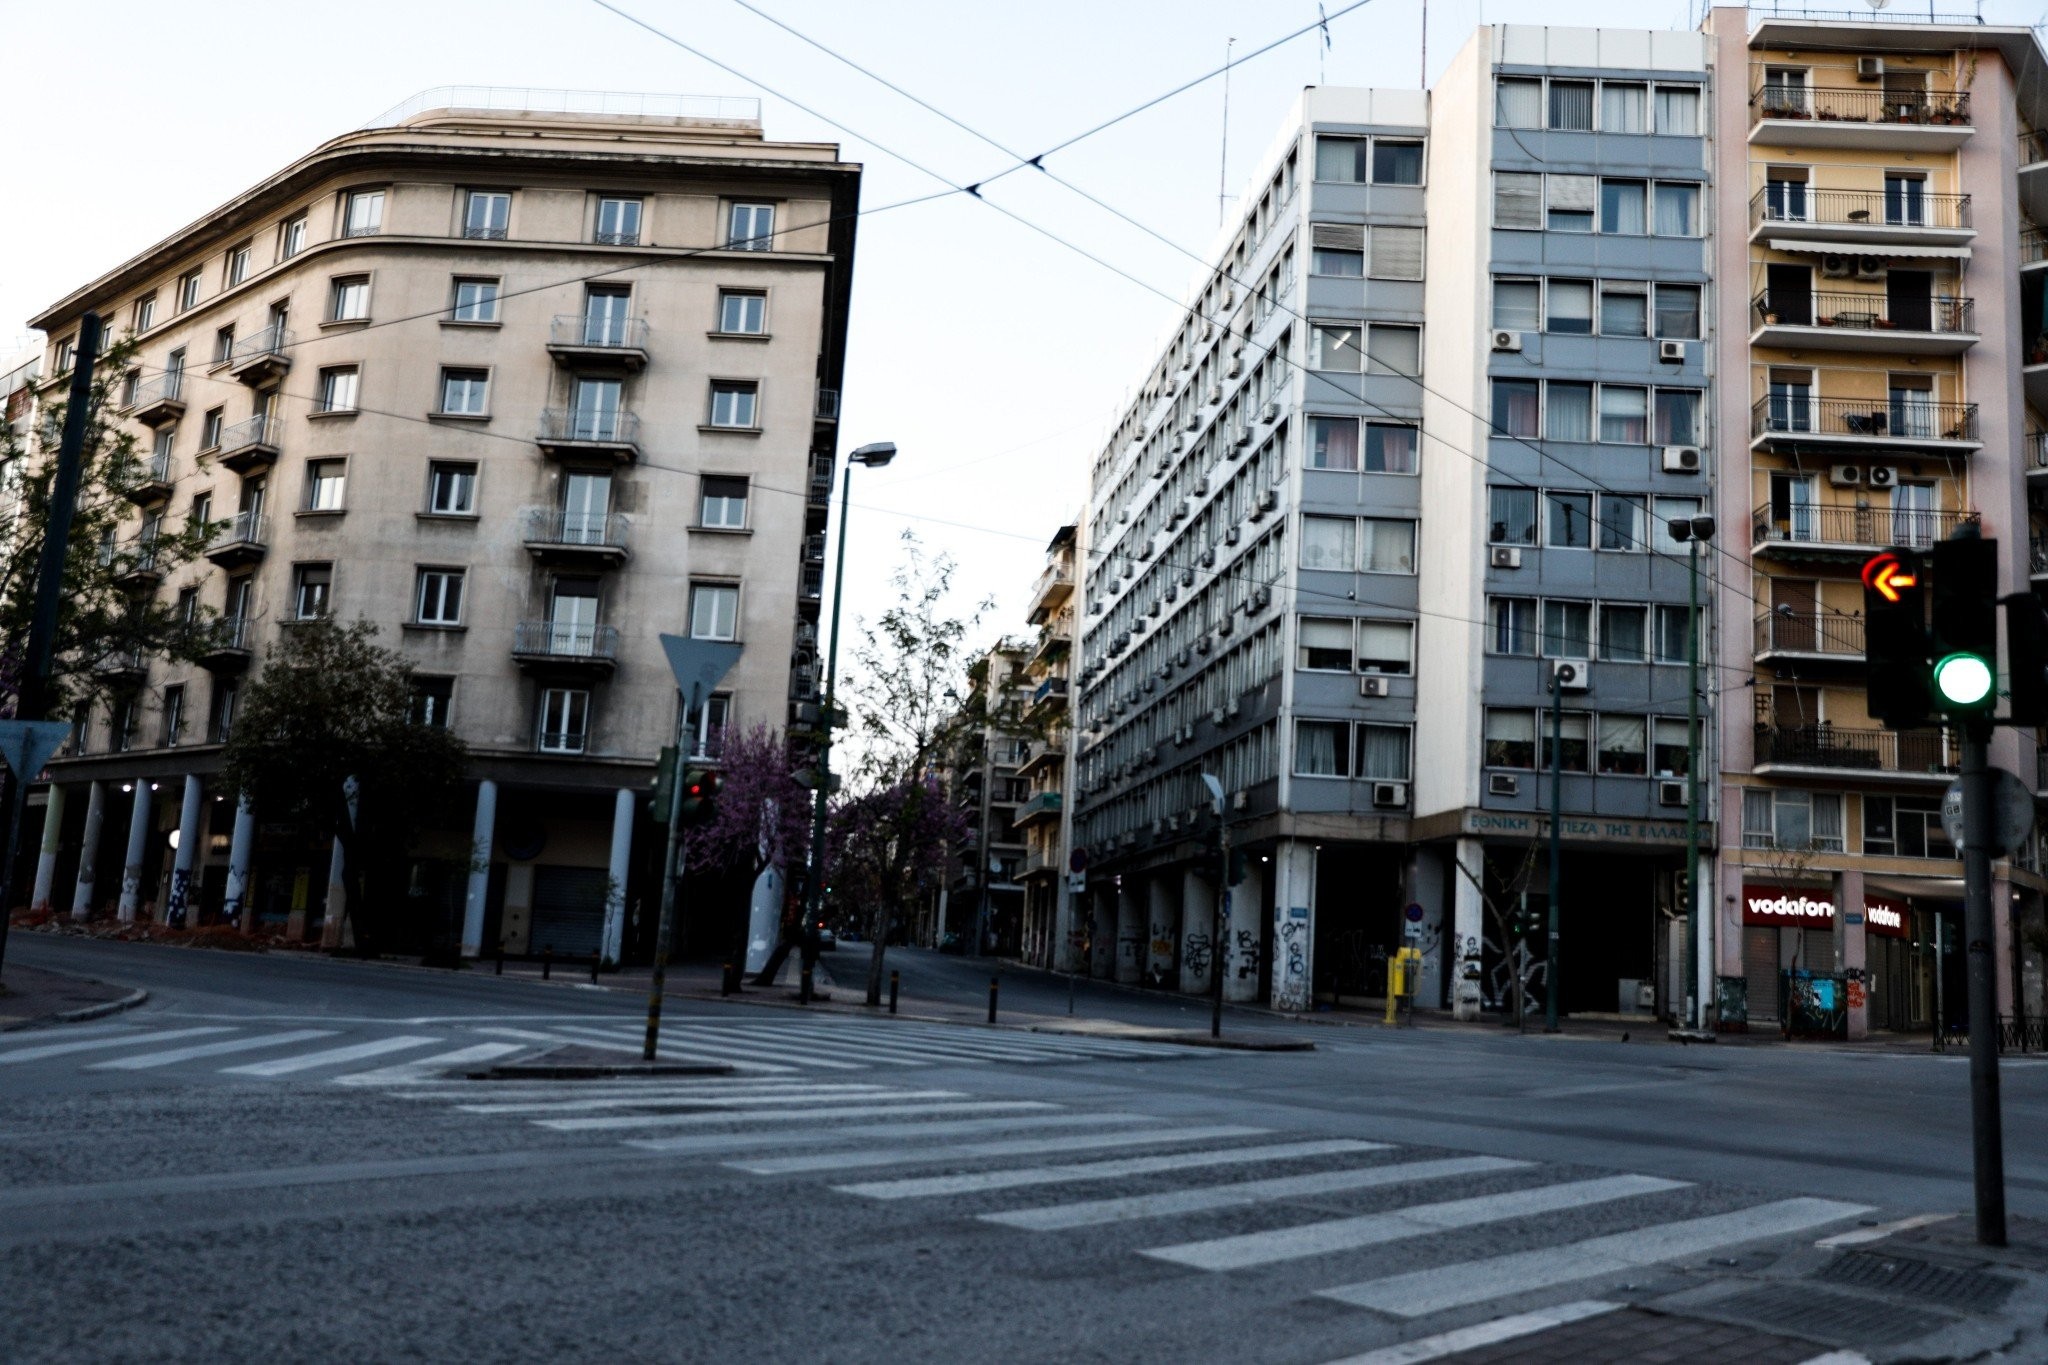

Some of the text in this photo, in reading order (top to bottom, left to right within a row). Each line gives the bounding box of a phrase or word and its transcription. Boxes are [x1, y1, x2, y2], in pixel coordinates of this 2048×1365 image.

[1471, 814, 1528, 830] ΕΘΝΙΚΗ
[1536, 819, 1598, 834] ΤΠΕΖΑ
[1605, 823, 1631, 836] ΤΗΣ
[1748, 895, 1835, 917] vodafon
[1868, 904, 1901, 928] vodafone
